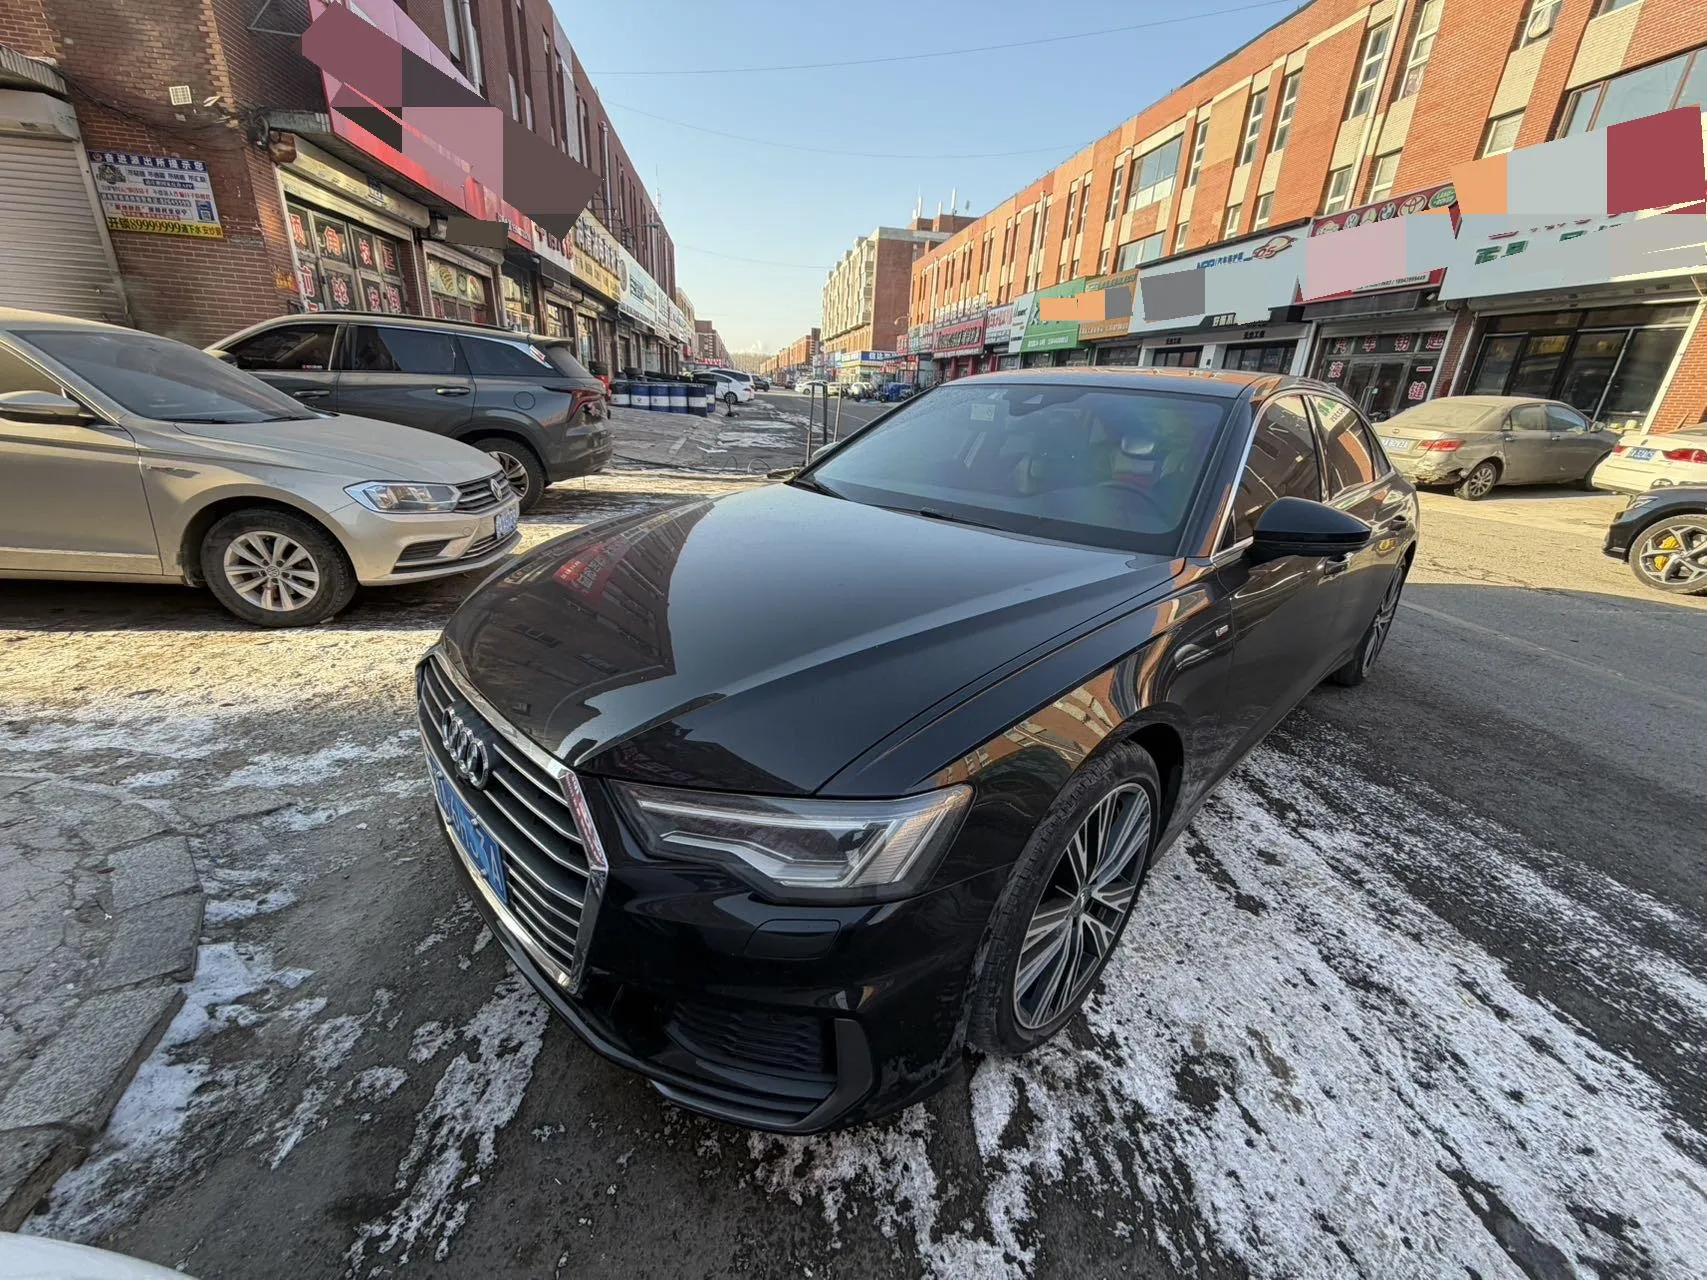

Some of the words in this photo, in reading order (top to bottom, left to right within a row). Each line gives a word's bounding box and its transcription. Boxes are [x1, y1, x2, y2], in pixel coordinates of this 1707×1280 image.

[104, 153, 204, 171] 奋进派出所提示您
